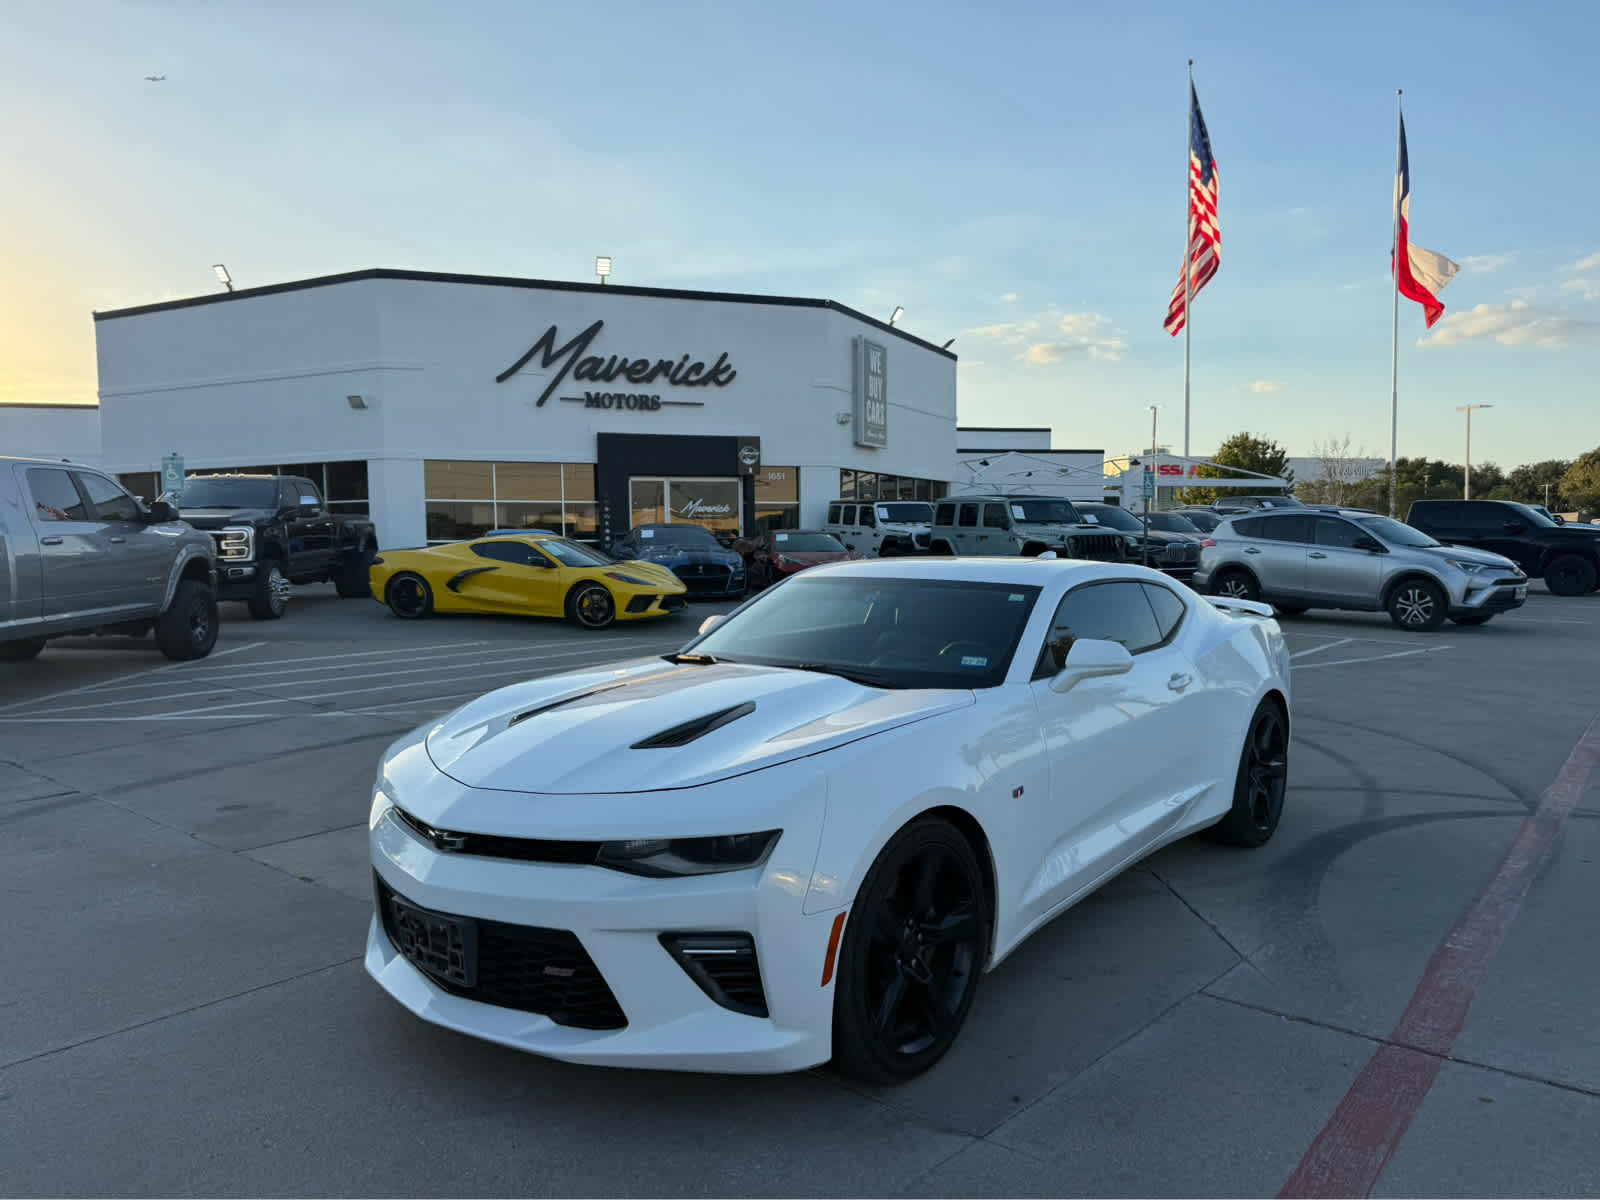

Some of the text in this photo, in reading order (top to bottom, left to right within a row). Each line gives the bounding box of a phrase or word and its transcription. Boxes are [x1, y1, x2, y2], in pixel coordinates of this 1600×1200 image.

[496, 319, 737, 407] Maverick
[870, 351, 881, 374] WE
[869, 375, 883, 401] BUY
[584, 391, 661, 411] MOTORS
[866, 400, 885, 425] CARS
[680, 498, 731, 518] Maverick
